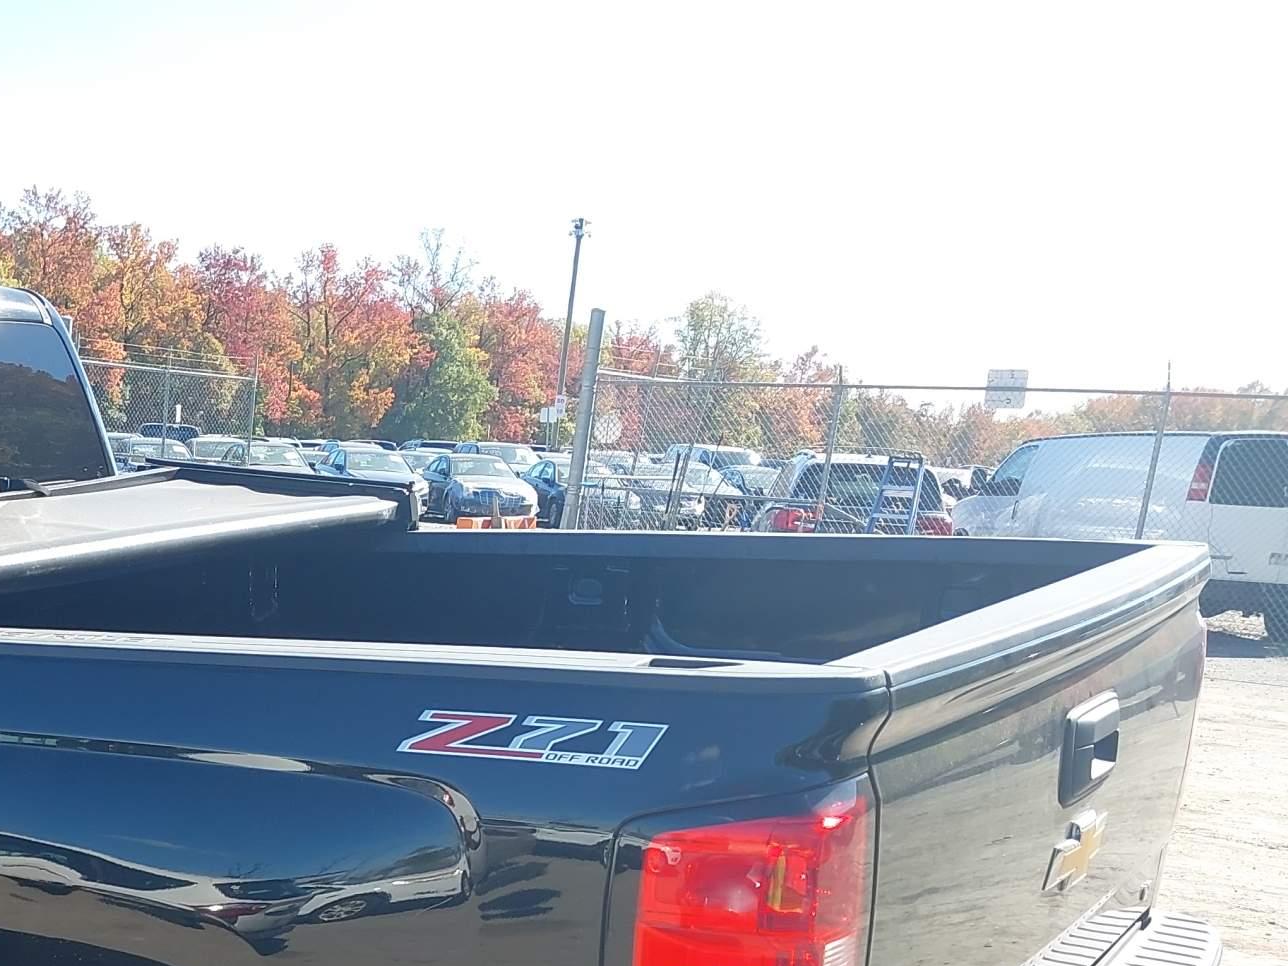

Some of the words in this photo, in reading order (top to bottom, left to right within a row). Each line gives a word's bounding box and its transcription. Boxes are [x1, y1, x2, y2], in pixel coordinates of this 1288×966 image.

[396, 709, 669, 770] Z71
[545, 752, 580, 764] OFF
[585, 755, 640, 769] ROAD
